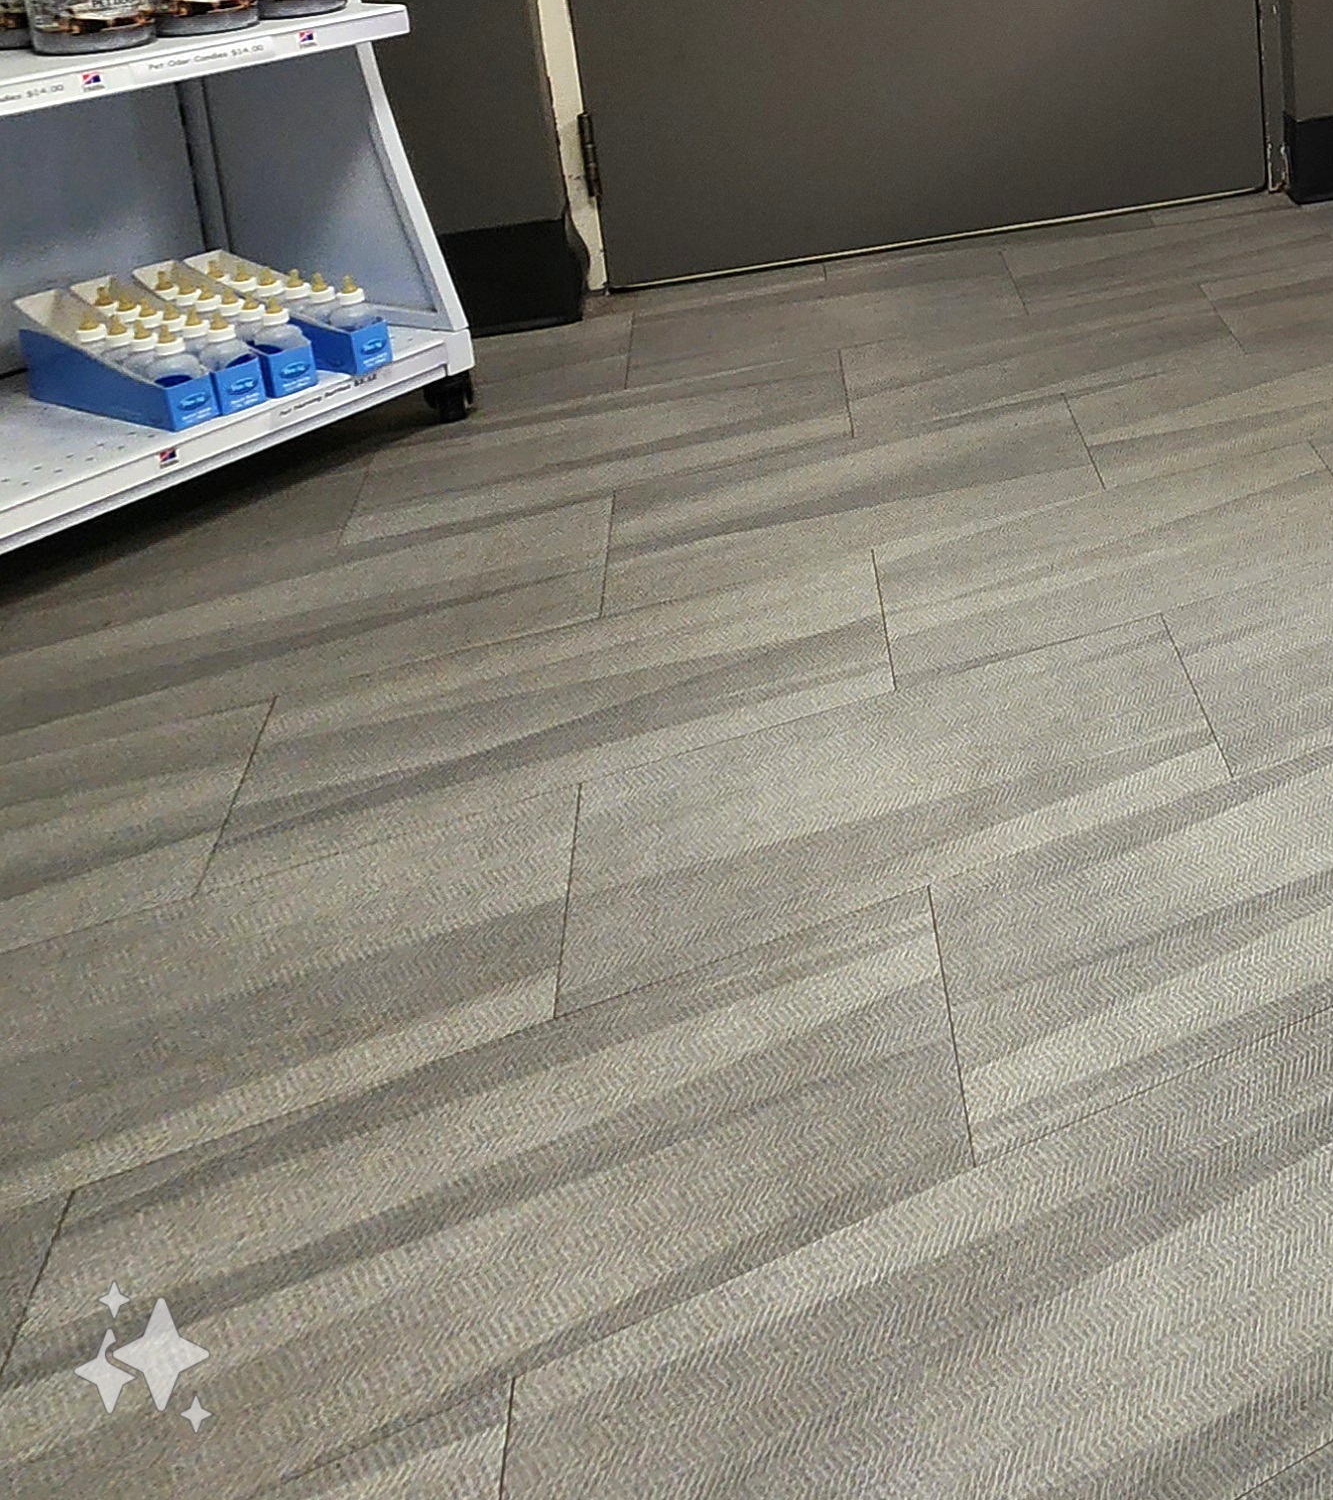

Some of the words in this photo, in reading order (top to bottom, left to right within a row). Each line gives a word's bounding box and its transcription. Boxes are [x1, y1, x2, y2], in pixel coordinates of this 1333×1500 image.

[148, 63, 165, 71] Pet
[167, 58, 190, 68] Odor
[194, 52, 228, 64] Candles
[231, 44, 264, 57] $14.00
